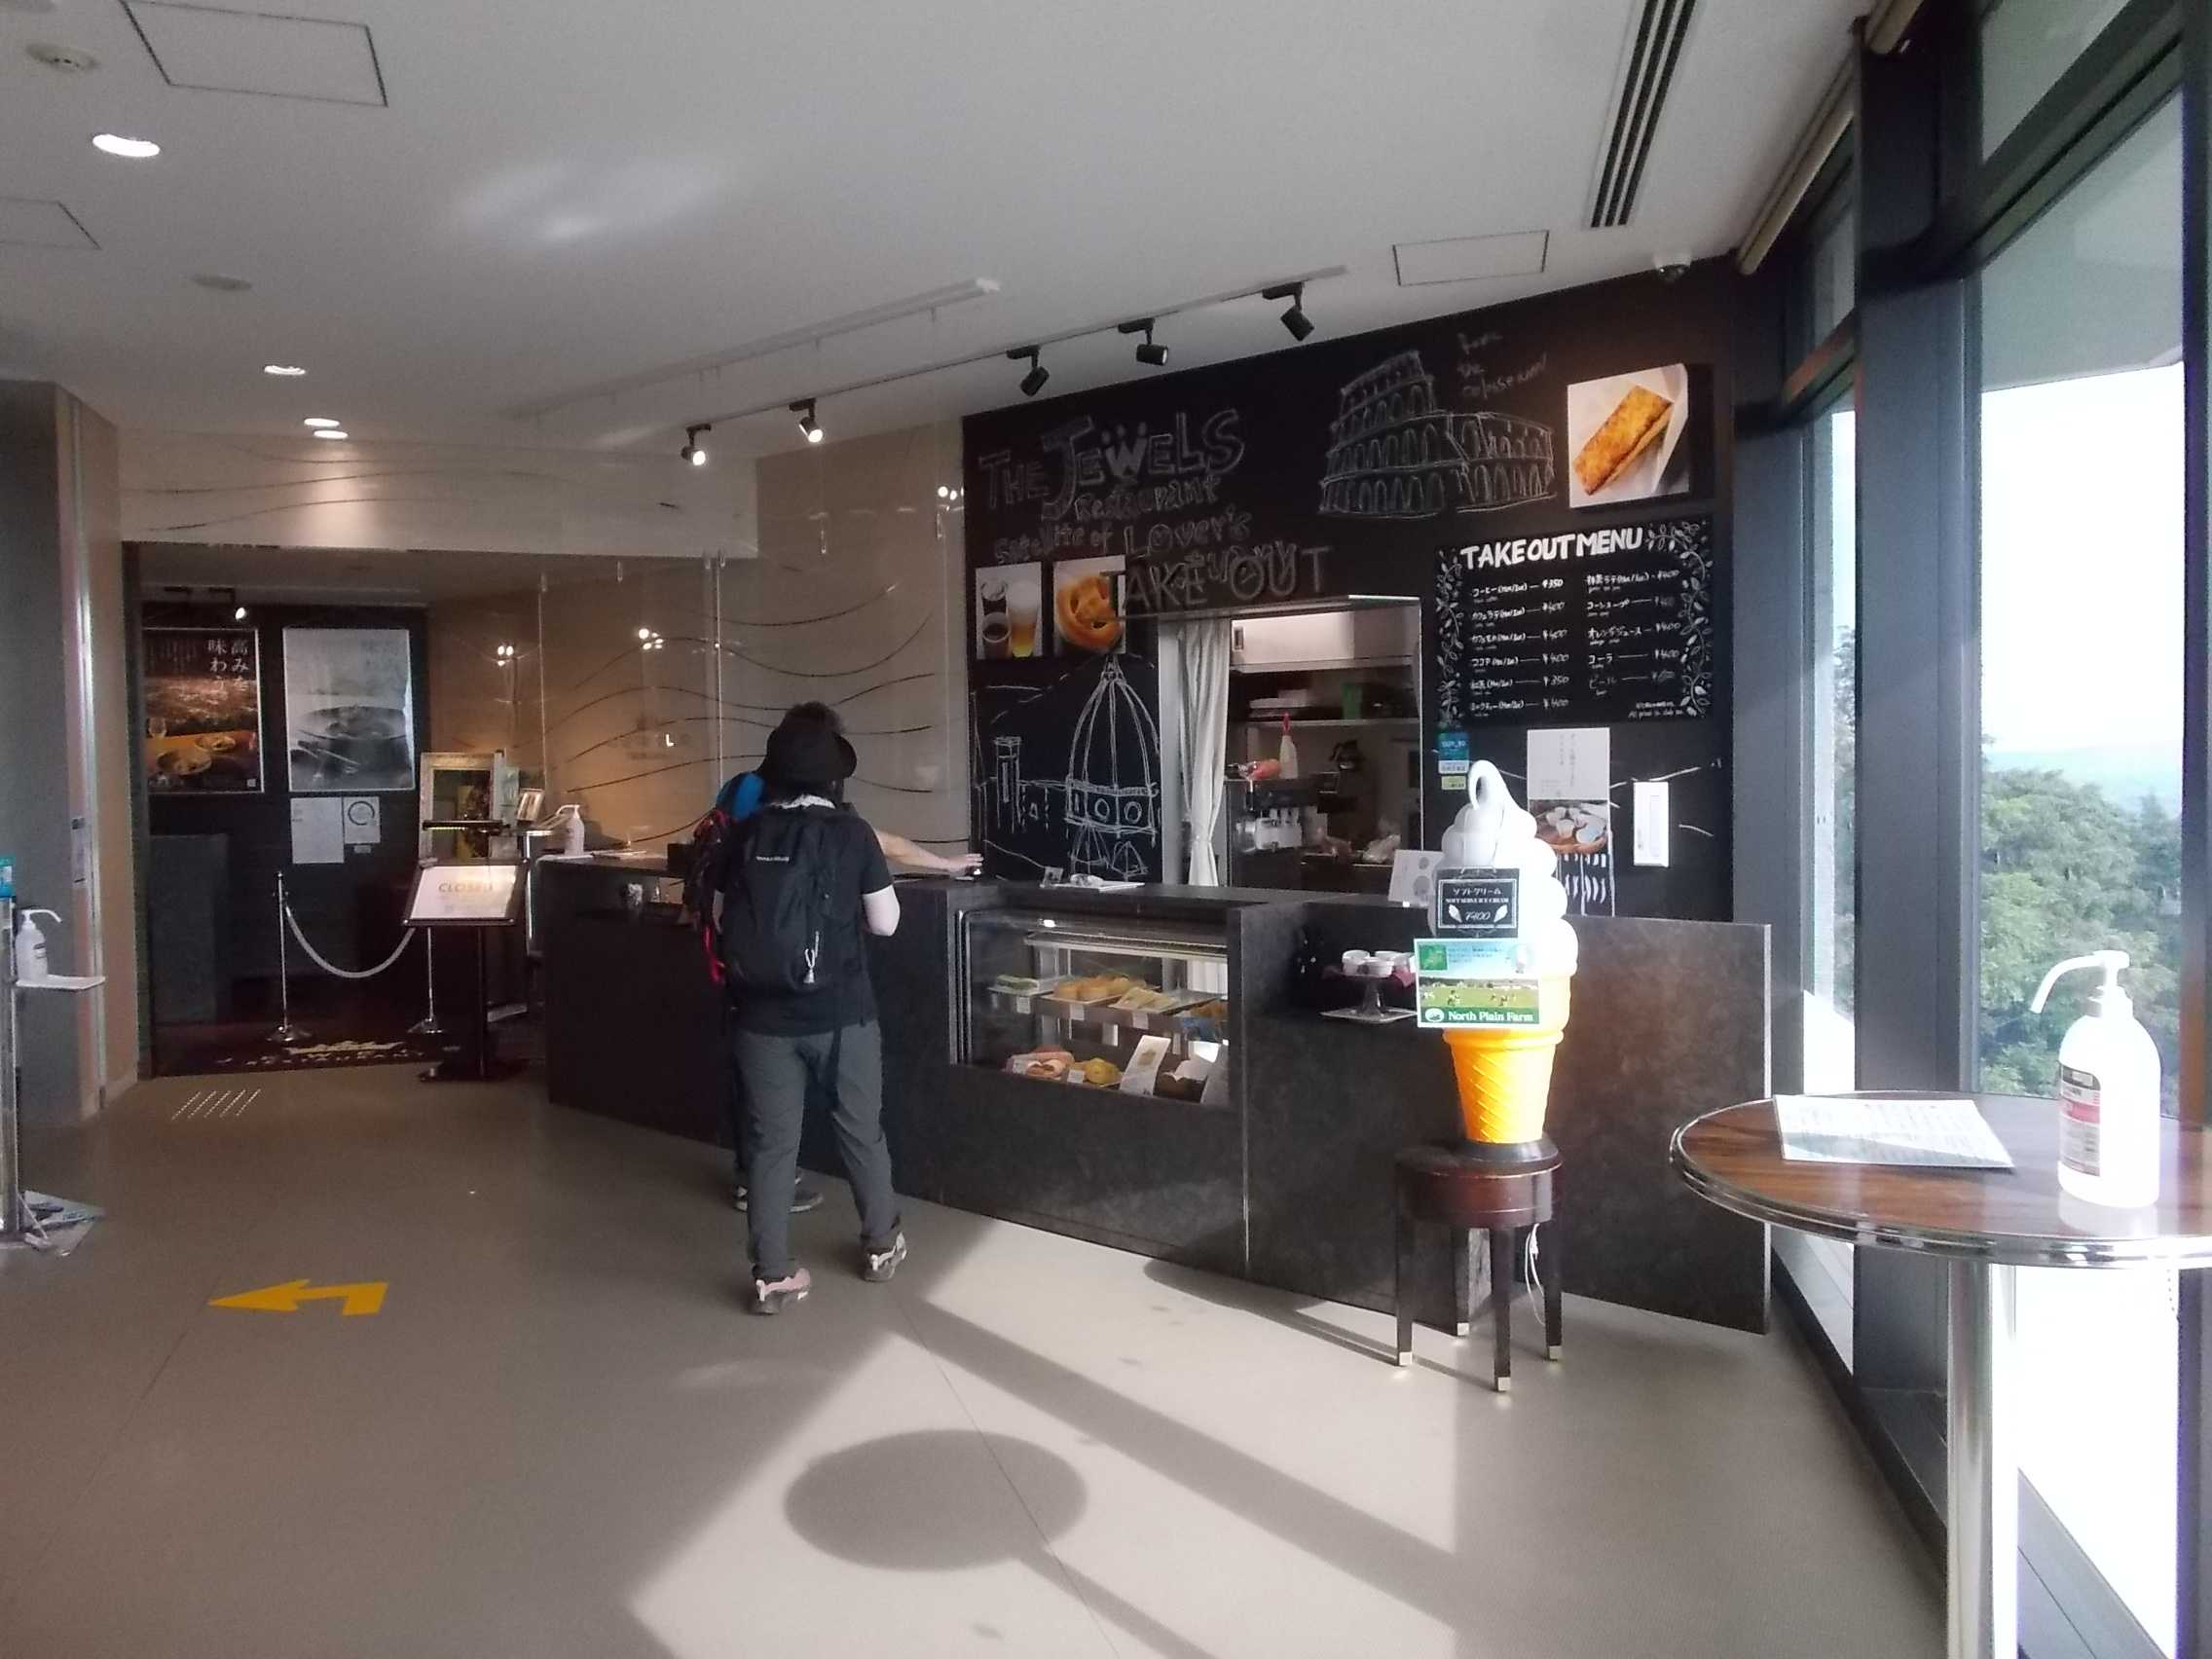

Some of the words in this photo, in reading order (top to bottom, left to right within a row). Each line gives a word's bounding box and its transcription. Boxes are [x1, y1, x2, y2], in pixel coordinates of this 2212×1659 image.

[978, 449, 1048, 509] THE
[1040, 409, 1246, 521] JEWELS
[1229, 545, 1337, 601] OUT
[1460, 538, 1527, 570] TAKE
[1575, 527, 1643, 557] MENU
[1448, 1011, 1477, 1021] North
[1479, 1012, 1504, 1021] Plain
[1506, 1012, 1533, 1021] Farm
